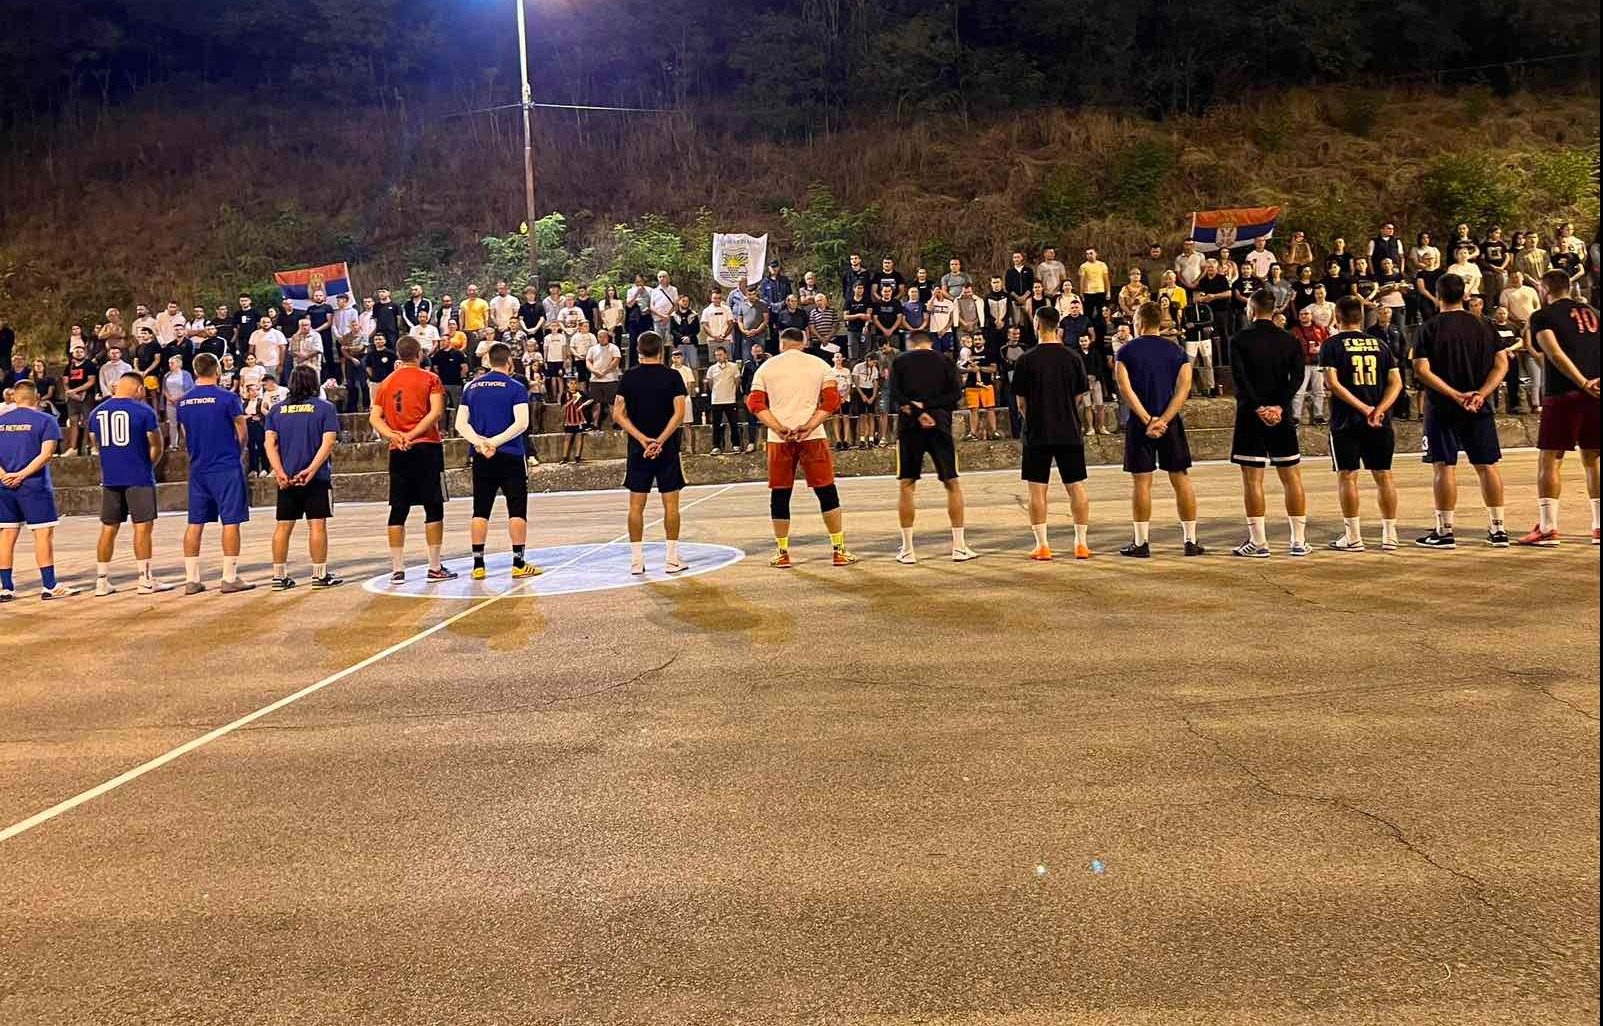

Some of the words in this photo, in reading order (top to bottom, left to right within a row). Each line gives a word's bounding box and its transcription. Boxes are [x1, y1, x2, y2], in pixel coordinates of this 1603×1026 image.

[1570, 307, 1598, 333] 10
[1351, 355, 1377, 386] 33
[96, 410, 130, 447] 10
